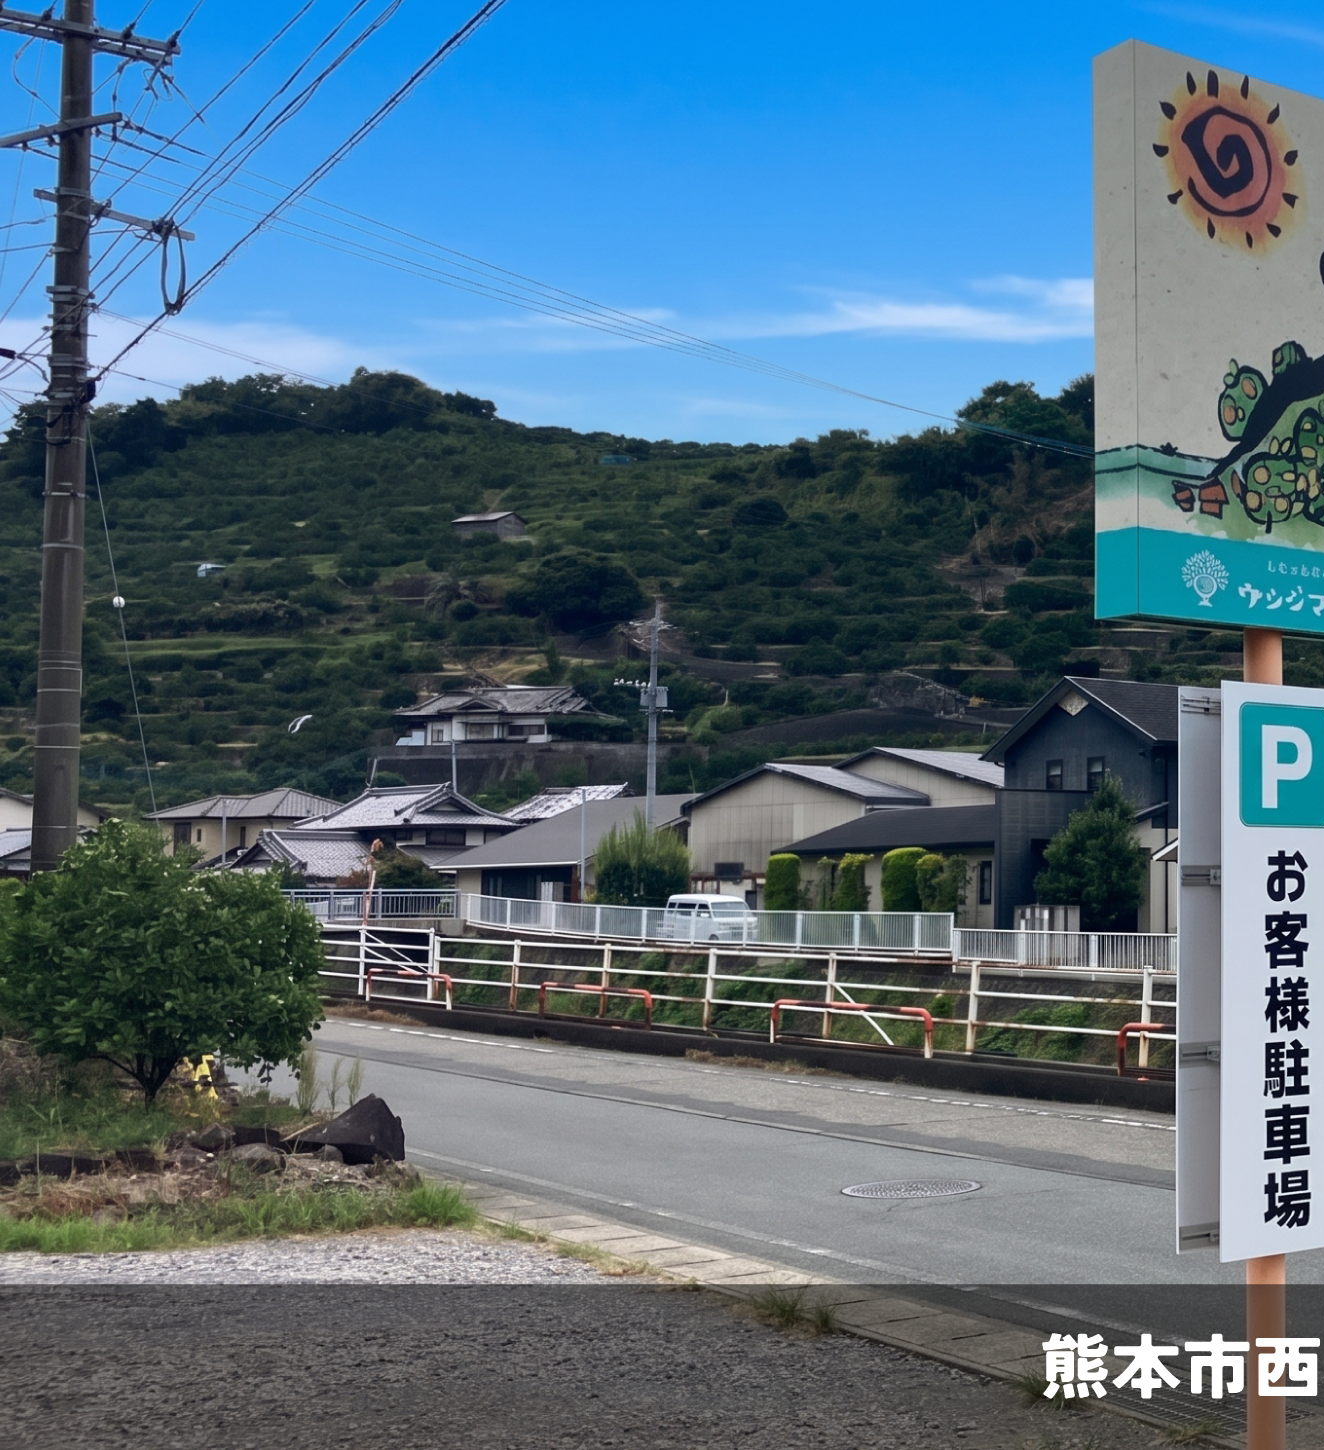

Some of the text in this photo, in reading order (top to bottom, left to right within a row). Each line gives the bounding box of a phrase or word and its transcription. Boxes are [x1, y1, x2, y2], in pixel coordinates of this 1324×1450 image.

[1261, 724, 1313, 809] P
[1264, 850, 1311, 1229] お客様駐車場
